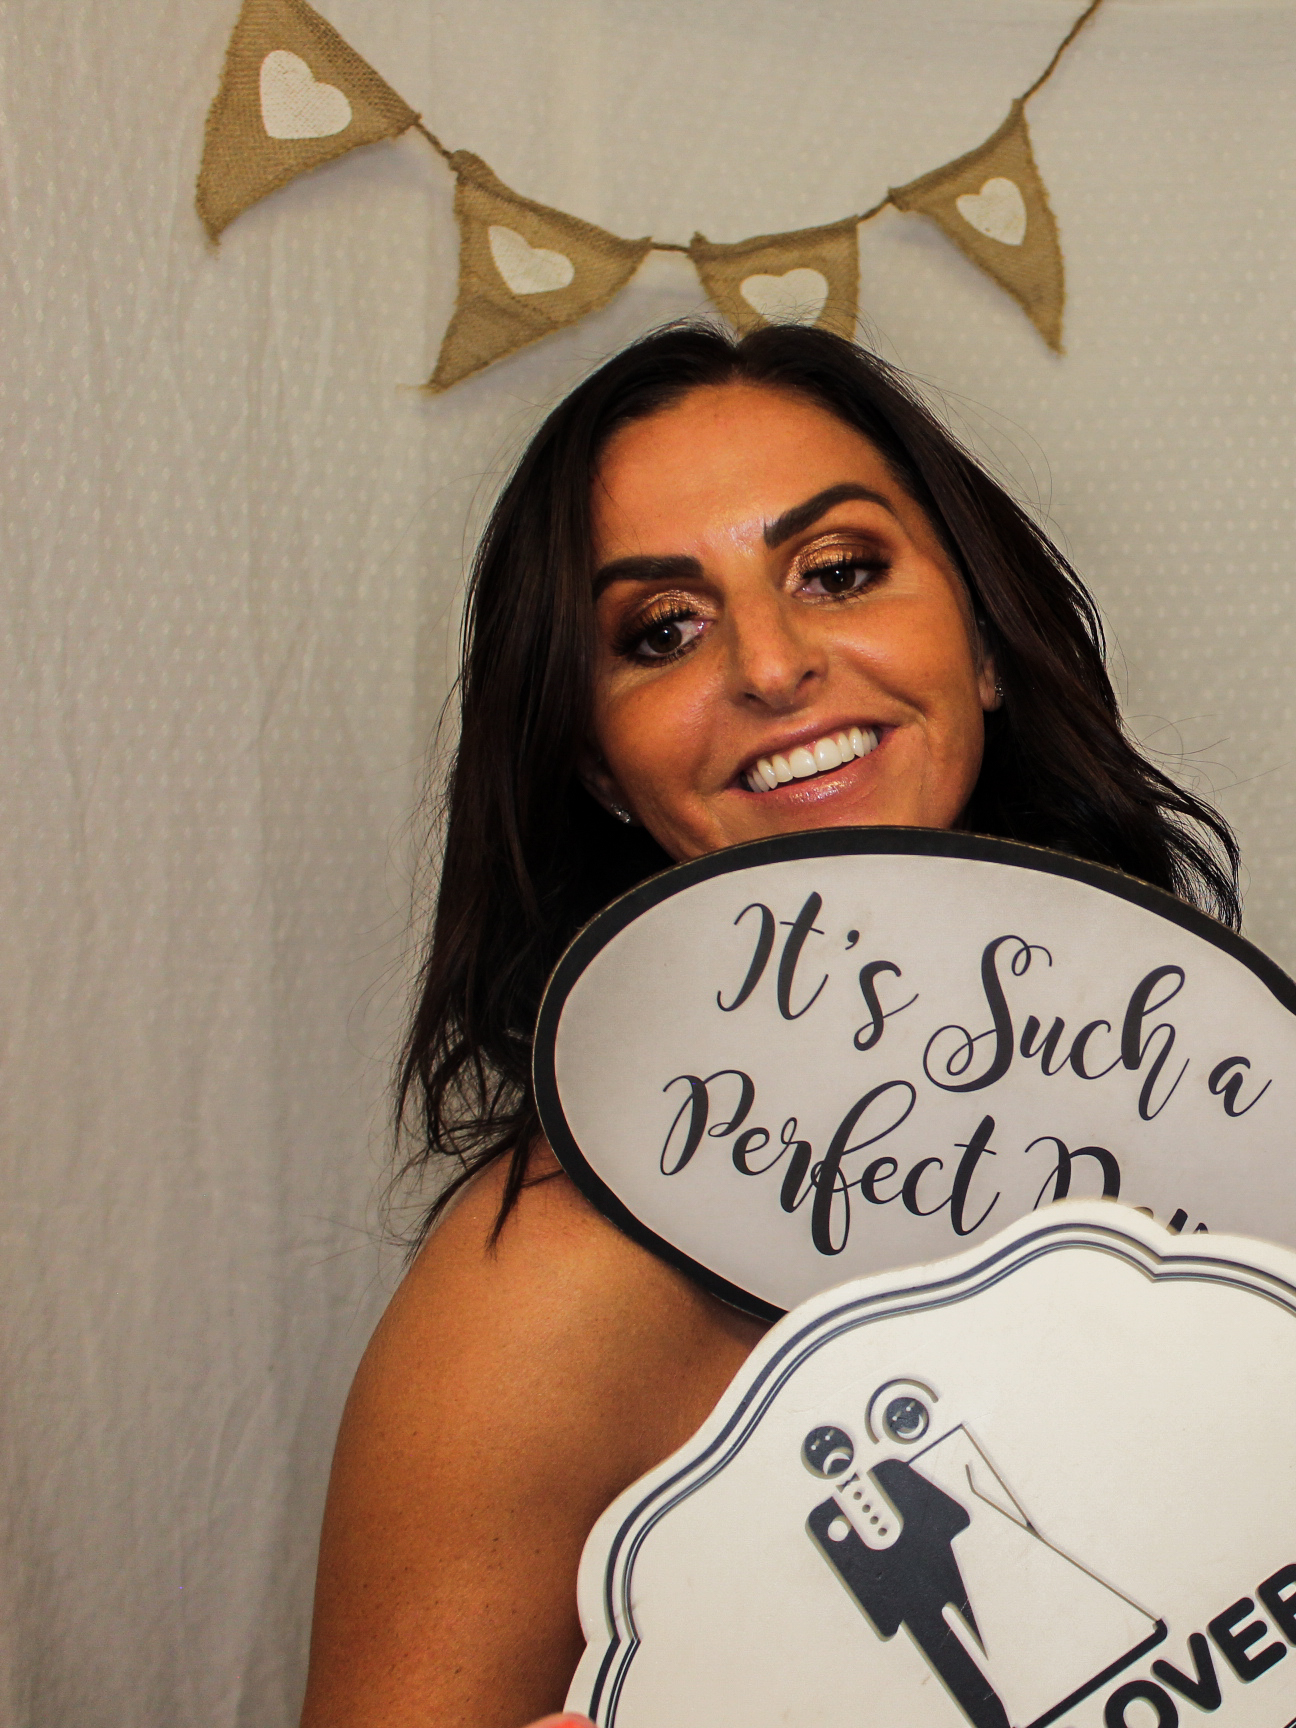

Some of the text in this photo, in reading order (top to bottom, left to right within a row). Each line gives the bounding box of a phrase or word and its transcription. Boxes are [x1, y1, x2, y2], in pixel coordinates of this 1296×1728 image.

[716, 891, 1273, 1121] It's Such a
[660, 1069, 1001, 1257] Perfect
